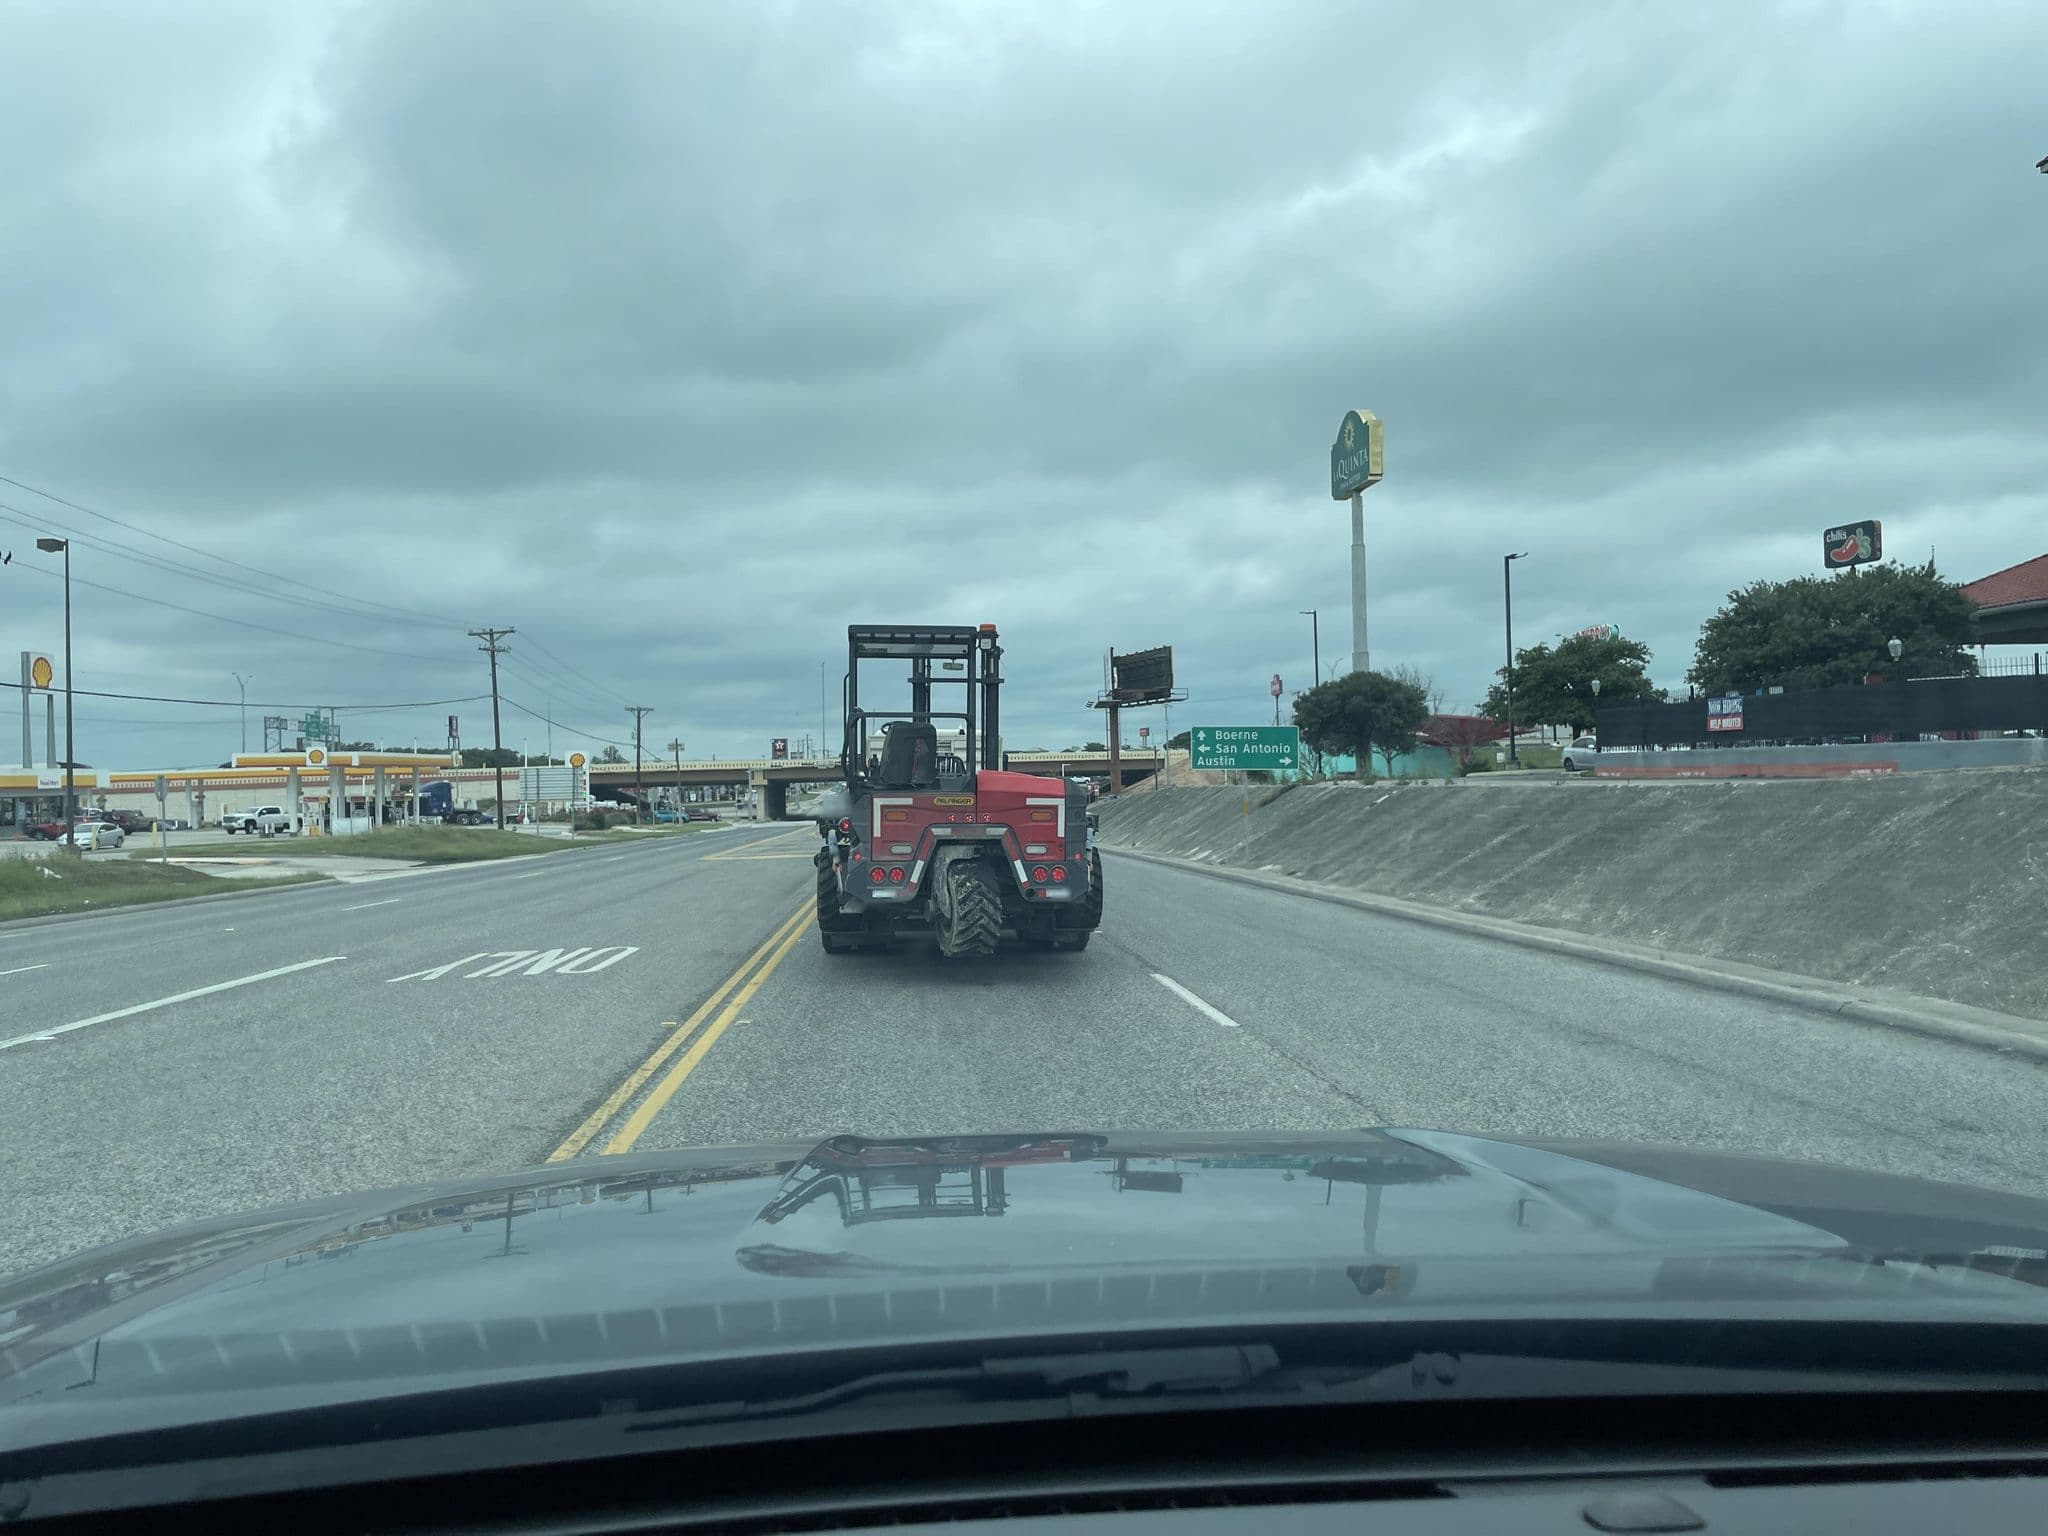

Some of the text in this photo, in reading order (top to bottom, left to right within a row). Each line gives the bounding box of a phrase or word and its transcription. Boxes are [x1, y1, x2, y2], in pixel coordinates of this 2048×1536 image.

[1338, 448, 1368, 479] QUINTA
[1215, 730, 1258, 740] Boerne
[1216, 743, 1291, 754] San Antonio
[1197, 756, 1235, 766] Austin
[383, 946, 640, 983] ONLY
